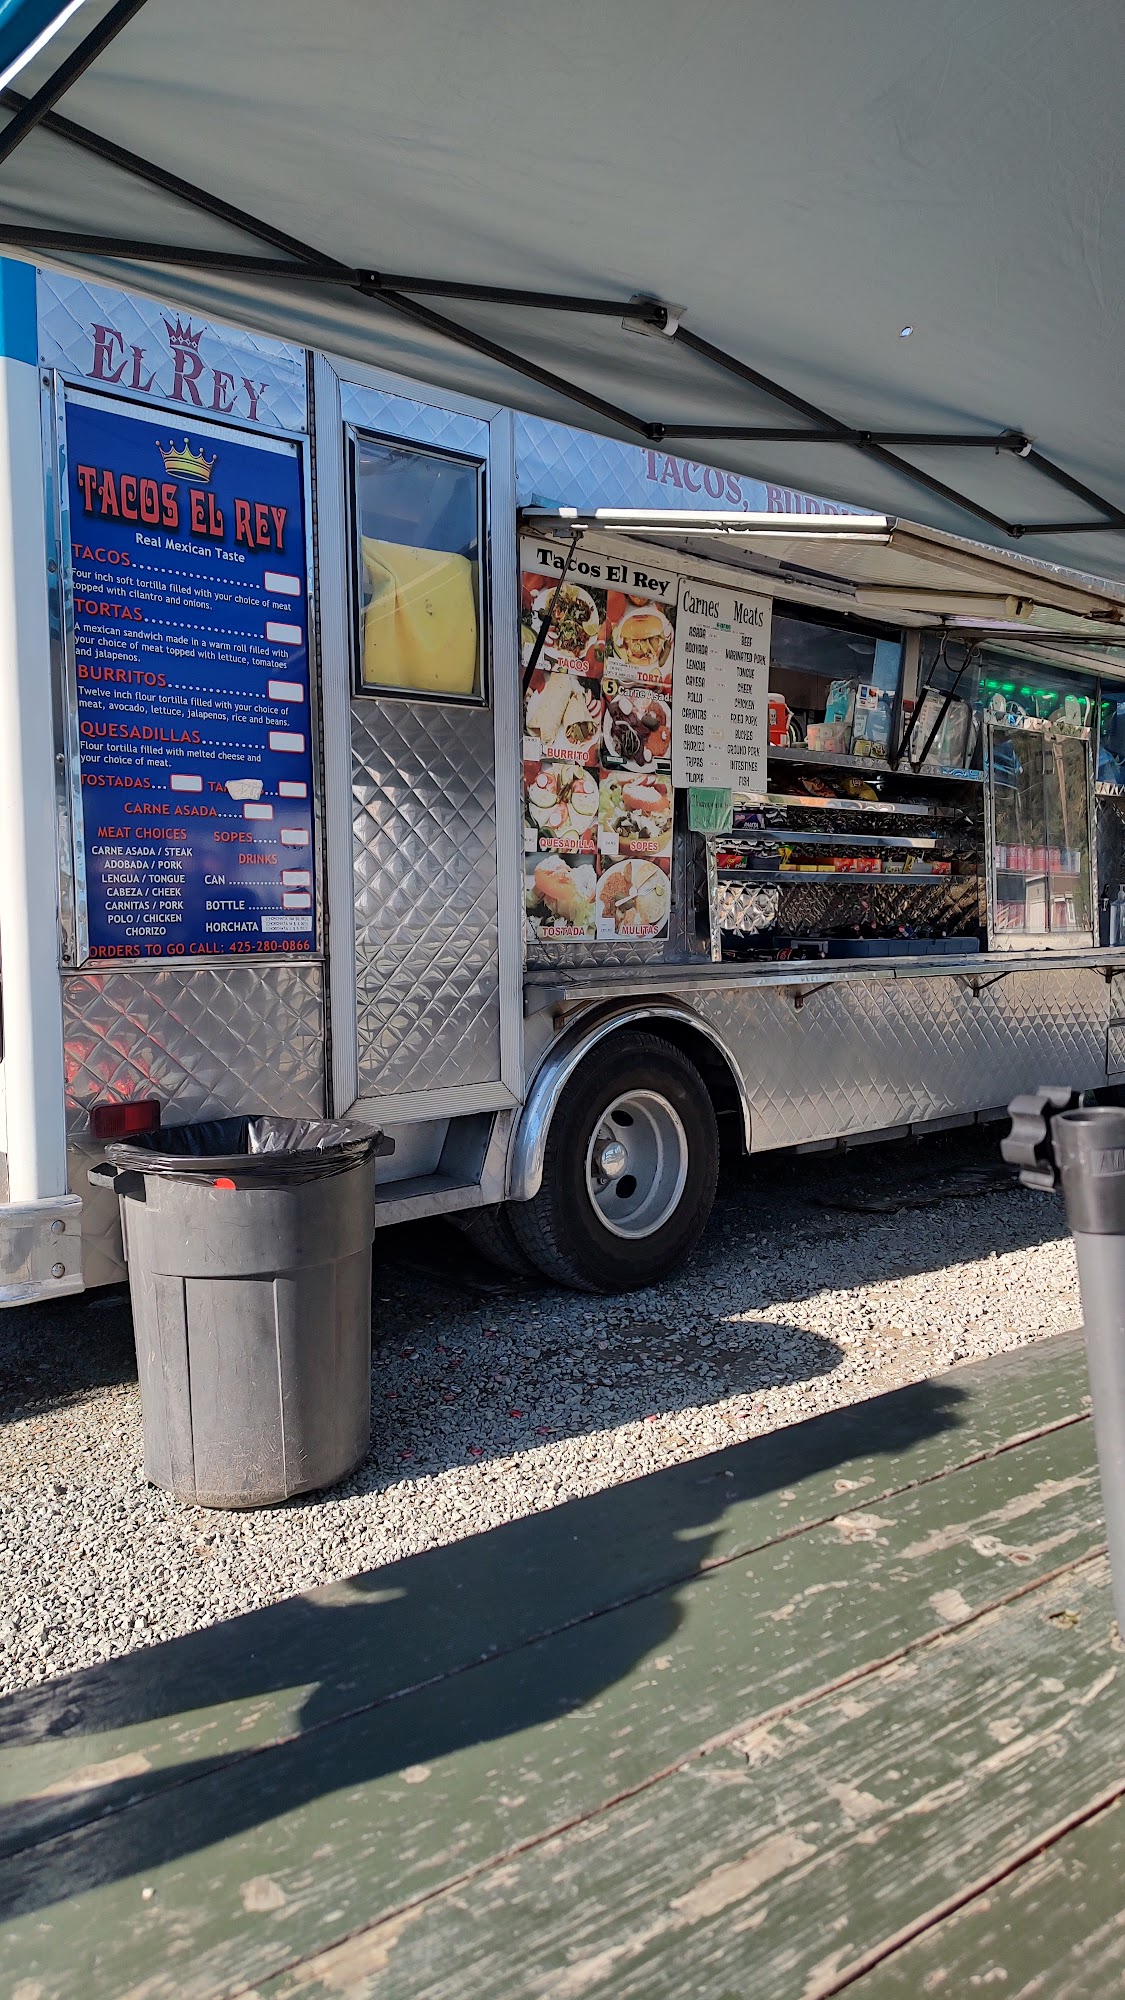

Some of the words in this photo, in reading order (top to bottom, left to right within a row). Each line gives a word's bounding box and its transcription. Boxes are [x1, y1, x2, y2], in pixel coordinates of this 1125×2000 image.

[86, 322, 156, 392] EL
[167, 346, 269, 421] REY
[77, 464, 178, 527] TACOS
[190, 489, 223, 537] EL
[235, 498, 286, 549] REY
[135, 533, 161, 548] Real
[165, 538, 211, 557] Mexican
[215, 547, 245, 563] Taste
[537, 548, 601, 578] Tacos
[605, 565, 628, 583] El
[632, 571, 671, 596] Rey
[72, 568, 91, 579] Four
[95, 572, 113, 582] inch
[117, 576, 133, 586] soft
[137, 578, 166, 591] tortilla
[169, 584, 191, 594] filled
[194, 588, 212, 598] with
[214, 593, 232, 602] your
[235, 596, 260, 606] choice
[262, 600, 270, 608] of
[272, 602, 292, 611] meat
[72, 582, 103, 593] topped
[107, 587, 126, 596] with
[129, 590, 163, 602] cilantro
[165, 596, 181, 605] and
[683, 589, 719, 619] Carnes
[733, 600, 764, 628] Meats
[74, 622, 81, 631] A
[83, 624, 120, 636] mexican
[123, 629, 163, 641] sandwich
[166, 635, 188, 644] made
[191, 637, 199, 646] in
[209, 641, 231, 651] warm
[233, 643, 247, 653] roll
[249, 645, 270, 656] filled
[272, 650, 289, 658] with
[75, 636, 95, 645] your
[98, 637, 127, 649] choice
[130, 641, 139, 650] of
[141, 643, 164, 653] meat
[166, 646, 195, 658] topped
[198, 650, 216, 659] with
[218, 652, 250, 666] lettuce,
[252, 658, 288, 669] tomatoes
[75, 647, 92, 656] and
[94, 649, 141, 662] jalapenos.
[556, 657, 590, 672] TACOS
[637, 671, 663, 683] TORTA
[606, 682, 614, 694] 5
[618, 686, 645, 698] Carne
[78, 686, 111, 697] Twelve
[114, 689, 132, 700] inch
[135, 692, 156, 701] flour
[158, 695, 188, 705] tortilla
[191, 697, 212, 708] filled
[215, 701, 232, 710] with
[235, 703, 252, 712] your
[254, 705, 279, 715] choice
[281, 707, 289, 715] of
[79, 700, 105, 711] meat,
[109, 702, 148, 714] avocado,
[151, 705, 184, 717] lettuce,
[187, 709, 229, 722] jalapenos,
[231, 714, 247, 722] rice
[249, 716, 263, 724] and
[80, 741, 103, 751] Flour
[107, 743, 138, 754] tortilla
[141, 745, 163, 755] filled
[166, 747, 184, 757] with
[187, 749, 215, 759] melted
[218, 751, 245, 761] cheese
[247, 754, 261, 762] and
[547, 748, 589, 761] BURRITO
[80, 754, 101, 763] your
[104, 755, 132, 764] choice
[135, 757, 144, 765] of
[124, 802, 170, 815] CARNE
[174, 805, 217, 817] ASADA
[98, 826, 131, 838] MEAT
[135, 827, 187, 840] CHOICES
[214, 831, 253, 843] SOPES
[539, 837, 595, 850] QUESADILLA
[630, 840, 658, 851] SOPES
[91, 846, 123, 855] CARNE
[125, 847, 155, 856] ASADA
[164, 847, 193, 857] STEAK
[104, 860, 149, 869] ADOBADA
[158, 861, 182, 870] PORK
[239, 854, 278, 865] DRINKS
[102, 874, 140, 883] LENGUA
[148, 874, 185, 883] TONGUE
[204, 875, 226, 885] CAN
[106, 888, 143, 897] CABEZA
[152, 888, 181, 897] CHEEK
[105, 901, 150, 911] CARNITAS
[159, 901, 184, 910] PORK
[206, 901, 245, 911] BOTTLE
[107, 914, 134, 924] POLO
[143, 914, 182, 923] CHICKEN
[125, 927, 167, 937] CHORIZO
[206, 922, 259, 933] HORCHATA
[542, 926, 585, 937] TOSTADA
[622, 925, 659, 936] MULITAS
[89, 945, 140, 957] ORDERS
[145, 944, 162, 955] TO
[166, 943, 185, 955] GO
[189, 942, 224, 954] CALL:
[229, 939, 311, 953] 425-280-0866
